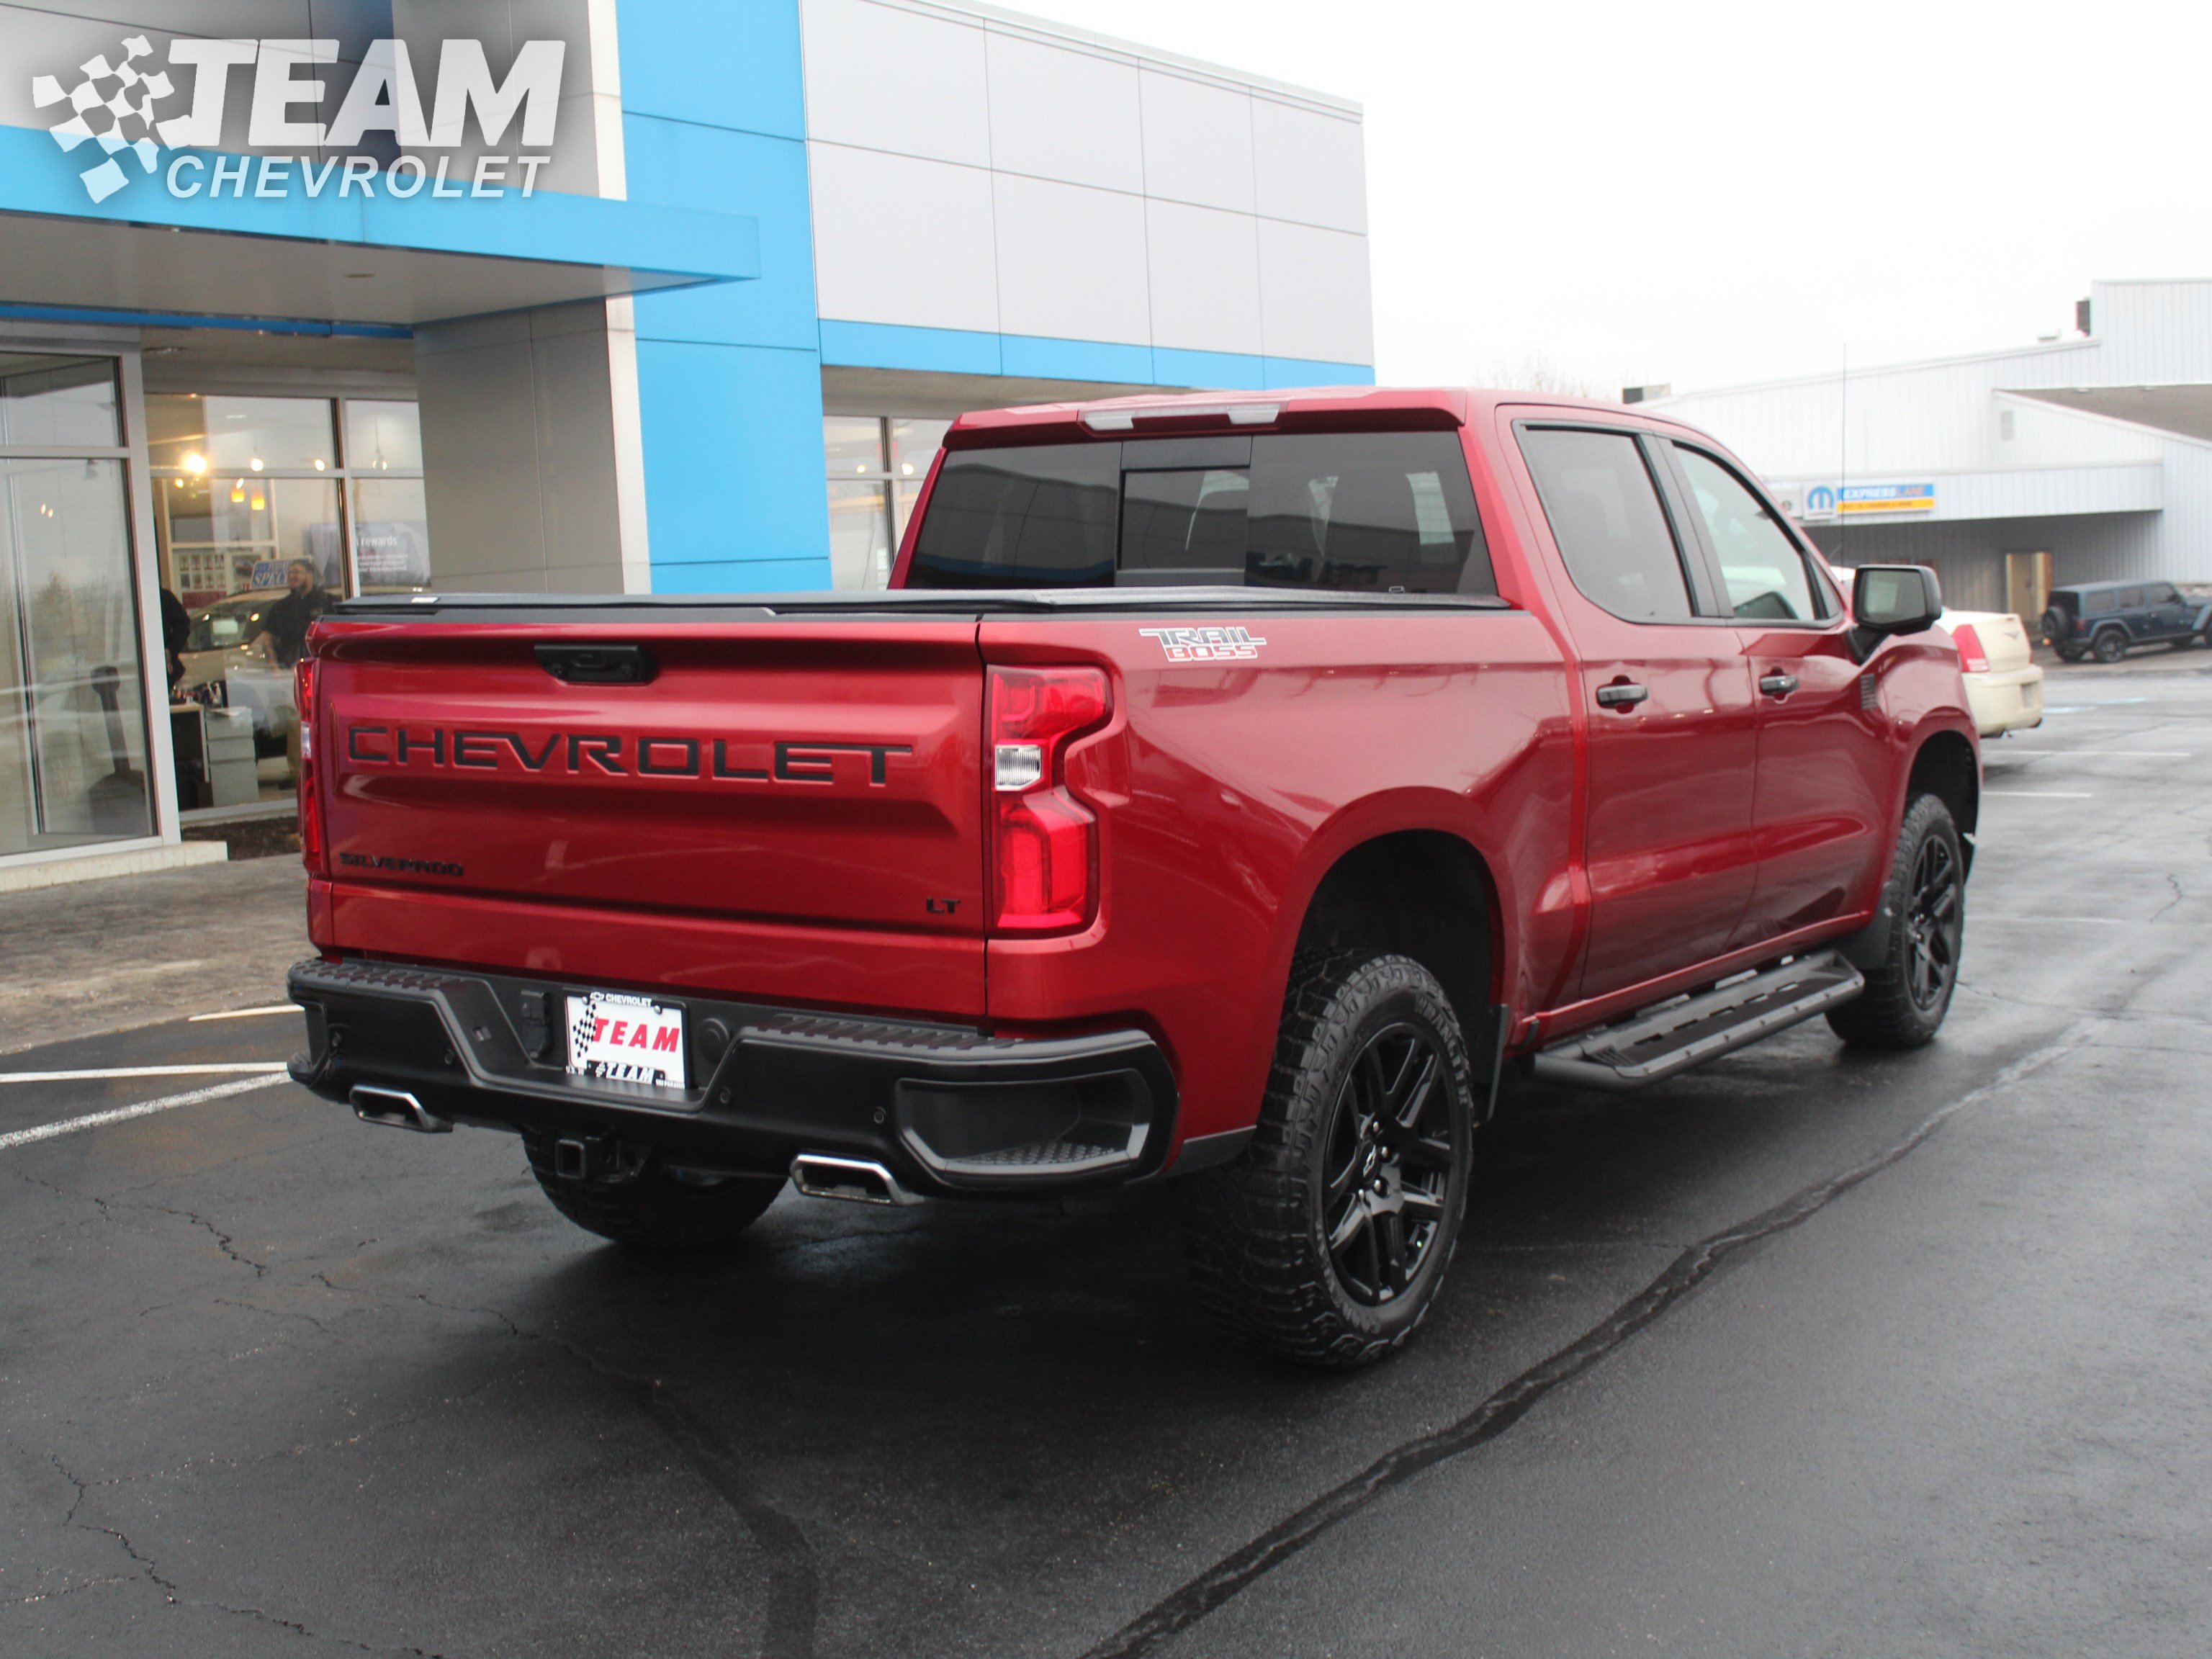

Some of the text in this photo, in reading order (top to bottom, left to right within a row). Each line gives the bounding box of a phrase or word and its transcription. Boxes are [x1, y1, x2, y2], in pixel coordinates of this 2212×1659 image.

[1842, 486, 1897, 500] EXPRESS
[360, 536, 397, 547] rewards
[1138, 626, 1267, 646] TRAIL
[1164, 644, 1259, 663] BOSS
[347, 725, 913, 788] CHEVROLET
[339, 852, 464, 876] SILVERADO
[926, 897, 962, 914] LT
[605, 992, 653, 1007] CHEVROLET
[593, 1017, 680, 1052] TEAM
